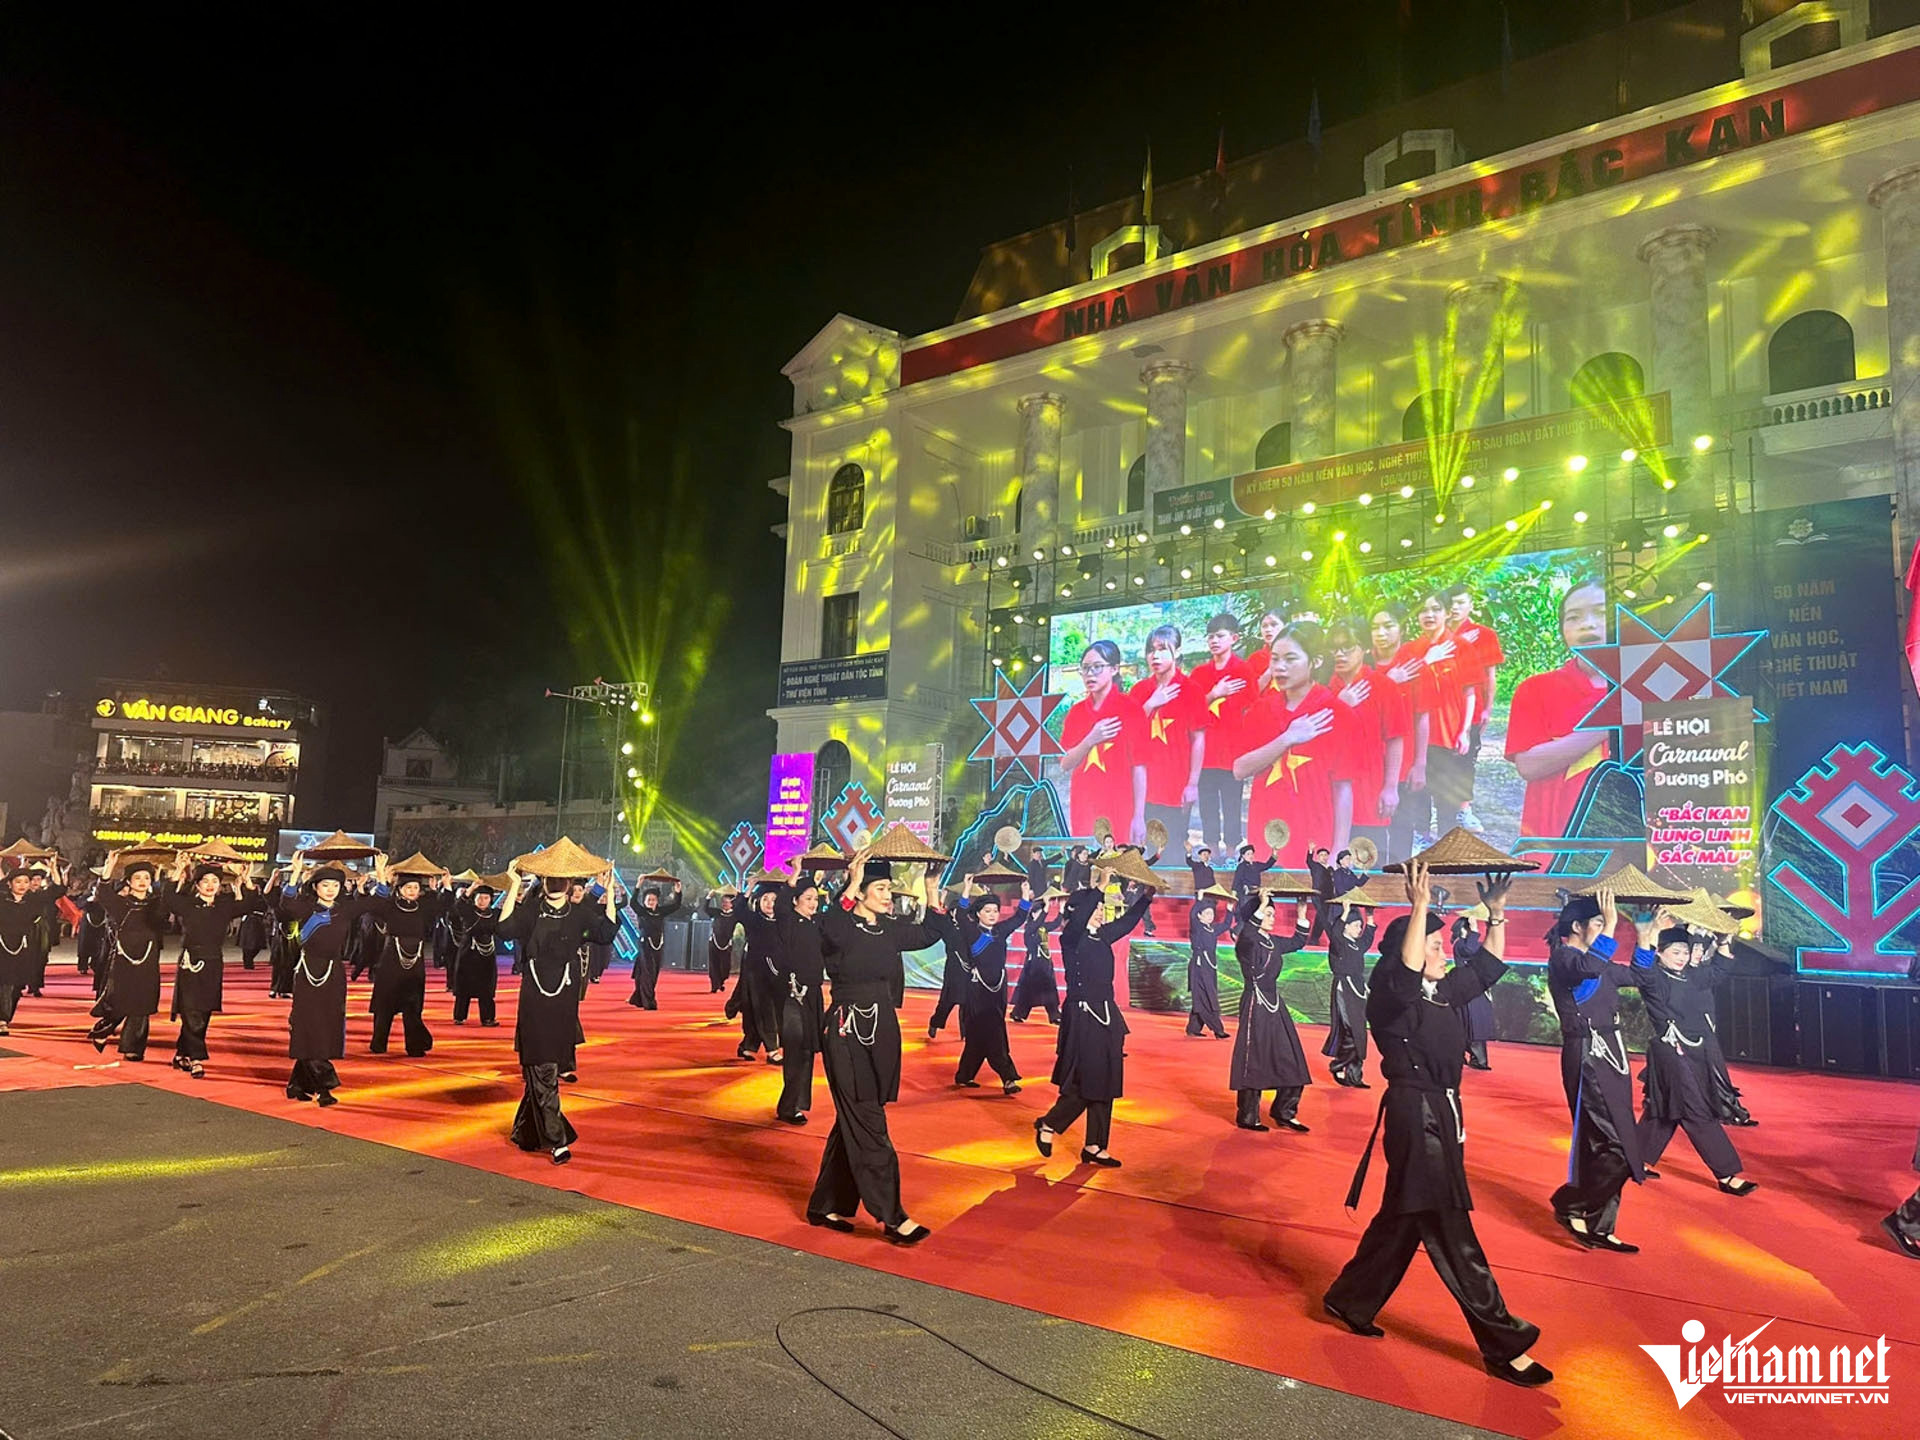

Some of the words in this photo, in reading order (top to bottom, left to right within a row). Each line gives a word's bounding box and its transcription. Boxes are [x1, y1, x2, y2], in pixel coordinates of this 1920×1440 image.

[1063, 287, 1129, 339] NHÀ
[1155, 264, 1232, 311] VĂN
[1773, 585, 1793, 600] 50
[1797, 578, 1836, 597] NĂM
[1771, 630, 1801, 649] VĂN
[1807, 629, 1844, 647] HỌC,
[1807, 652, 1858, 672] THUẬT
[1810, 678, 1848, 696] NAM
[168, 706, 239, 726] GIANG
[243, 716, 292, 731] Bakery
[1676, 717, 1710, 736] HỘI
[1649, 740, 1750, 767] Carnaval
[1706, 805, 1750, 826] KẠN
[1706, 827, 1752, 844] LINH
[1658, 843, 1696, 865] SẮC
